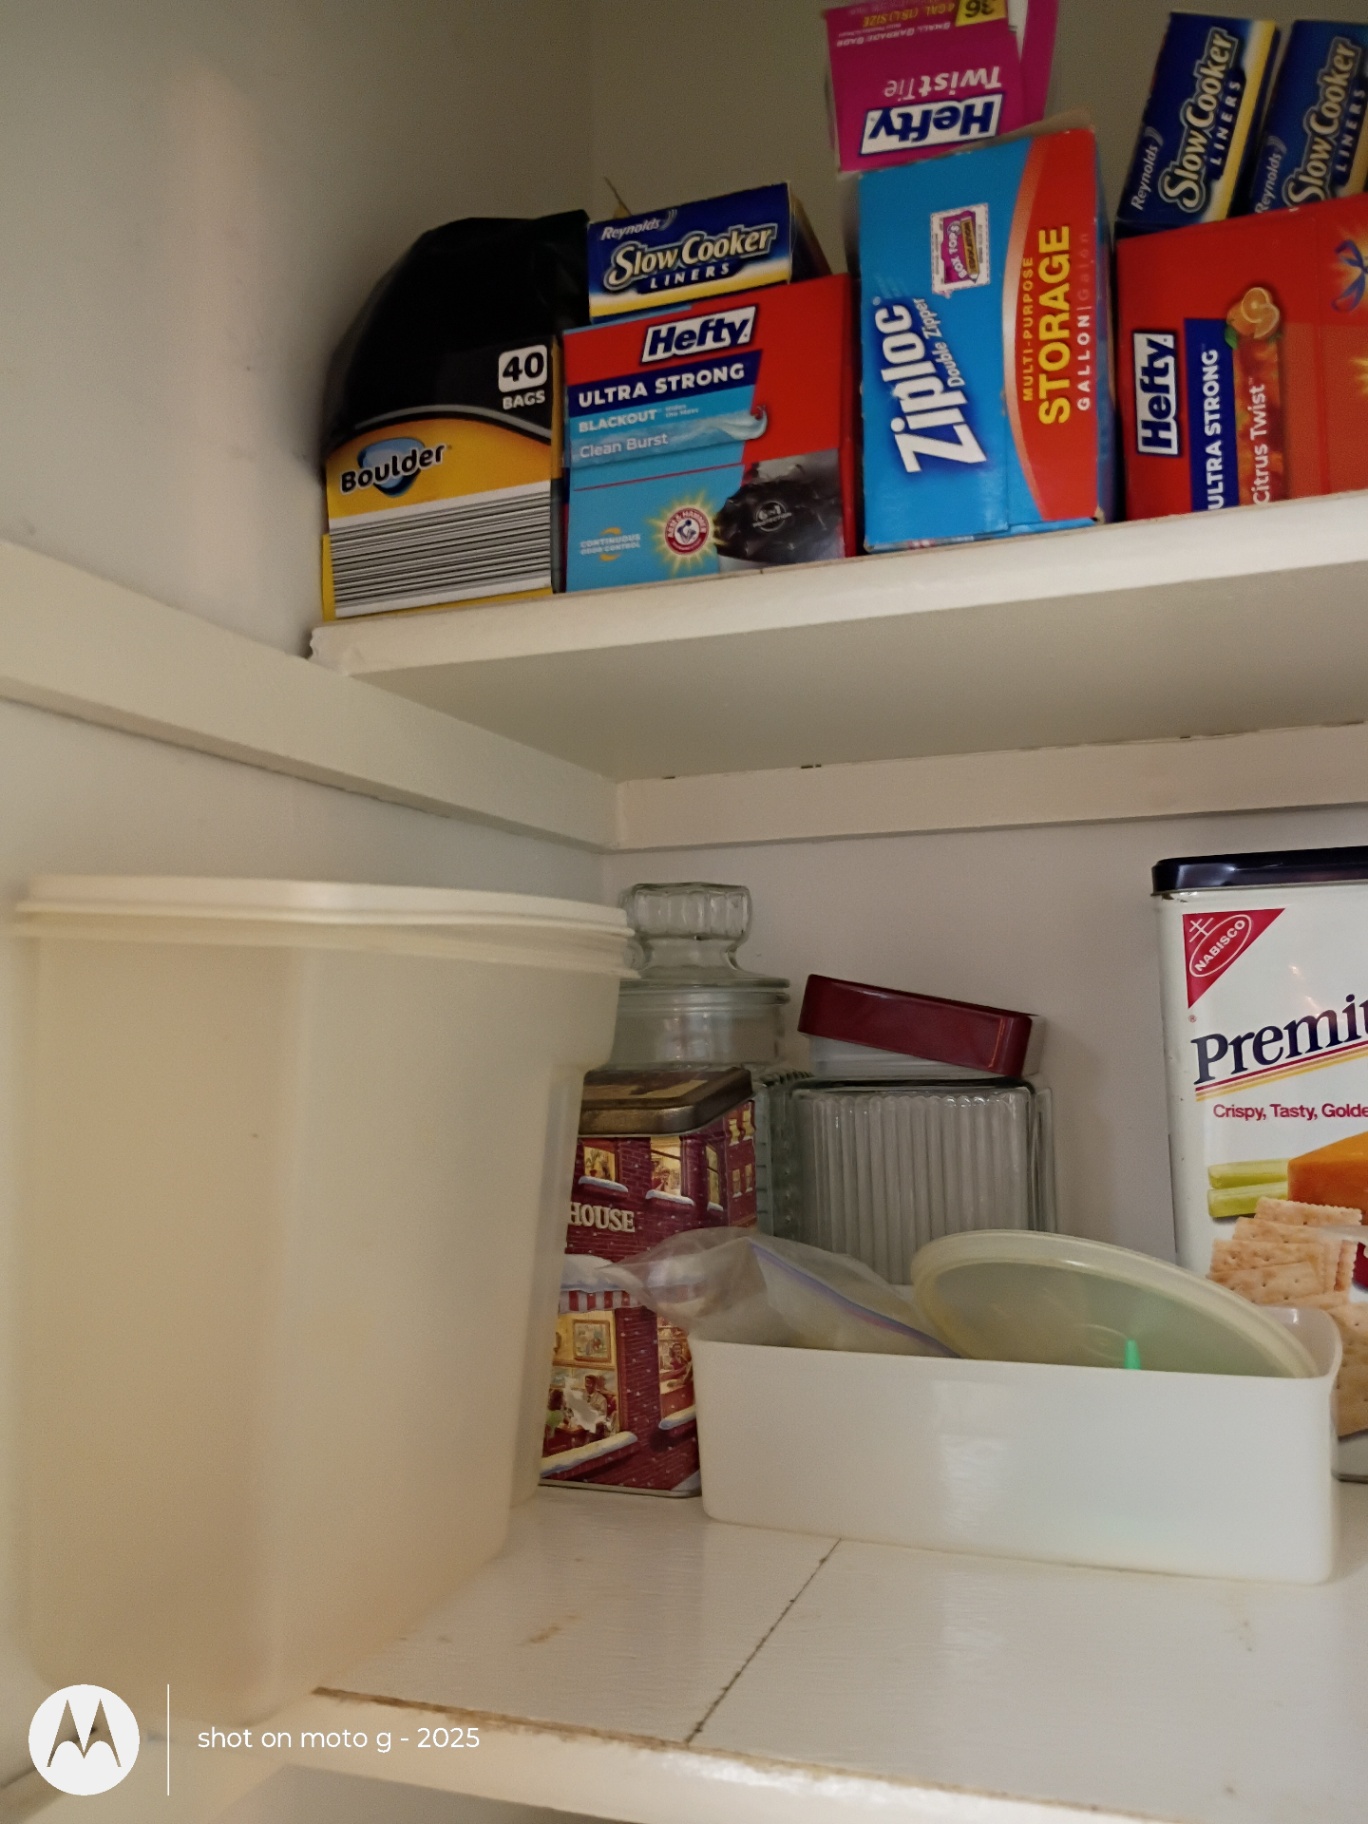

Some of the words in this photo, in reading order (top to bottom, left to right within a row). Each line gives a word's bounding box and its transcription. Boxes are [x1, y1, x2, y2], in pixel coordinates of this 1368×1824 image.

[964, 0, 996, 18] 36
[868, 101, 996, 143] Hefty
[1163, 129, 1207, 209] Slow
[1186, 33, 1233, 128] Cooker
[1209, 81, 1241, 166] LINERS
[1335, 89, 1367, 173] LINERS
[1131, 144, 1159, 211] Reynolds
[1254, 152, 1283, 214] Reynolds
[600, 218, 661, 241] Reynolds
[948, 224, 961, 255] TOPS
[607, 245, 679, 286] Slow
[681, 228, 773, 265] Cooker
[650, 263, 730, 289] LINERS
[950, 255, 967, 279] BOX
[648, 317, 751, 356] Hefty
[913, 298, 943, 340] Zipper
[1022, 256, 1034, 402] MULTI-PURPOSE
[1038, 225, 1071, 425] STORAGE
[502, 352, 545, 382] 40
[578, 382, 648, 408] ULTRA
[655, 363, 745, 394] STRONG
[934, 341, 966, 388] Double
[1077, 314, 1092, 412] GALLON
[502, 389, 546, 411] BAGS
[875, 304, 988, 473] Ziploc
[1139, 337, 1175, 450] Hefty
[1201, 349, 1221, 437] STRONG
[578, 409, 657, 433] BLACKOUT
[1248, 384, 1266, 442] Twist
[340, 445, 446, 493] Boulder
[580, 437, 622, 458] Clean
[626, 432, 669, 453] Burst
[1205, 440, 1225, 510] ULTRA
[1252, 443, 1271, 505] Citrus
[580, 533, 641, 548] CONTINUOUS
[1194, 919, 1246, 972] NABISCO
[1190, 993, 1368, 1085] Premi
[1213, 1103, 1267, 1121] Crispy,
[1270, 1103, 1318, 1121] Tasty,
[568, 1201, 636, 1233] HOUSE
